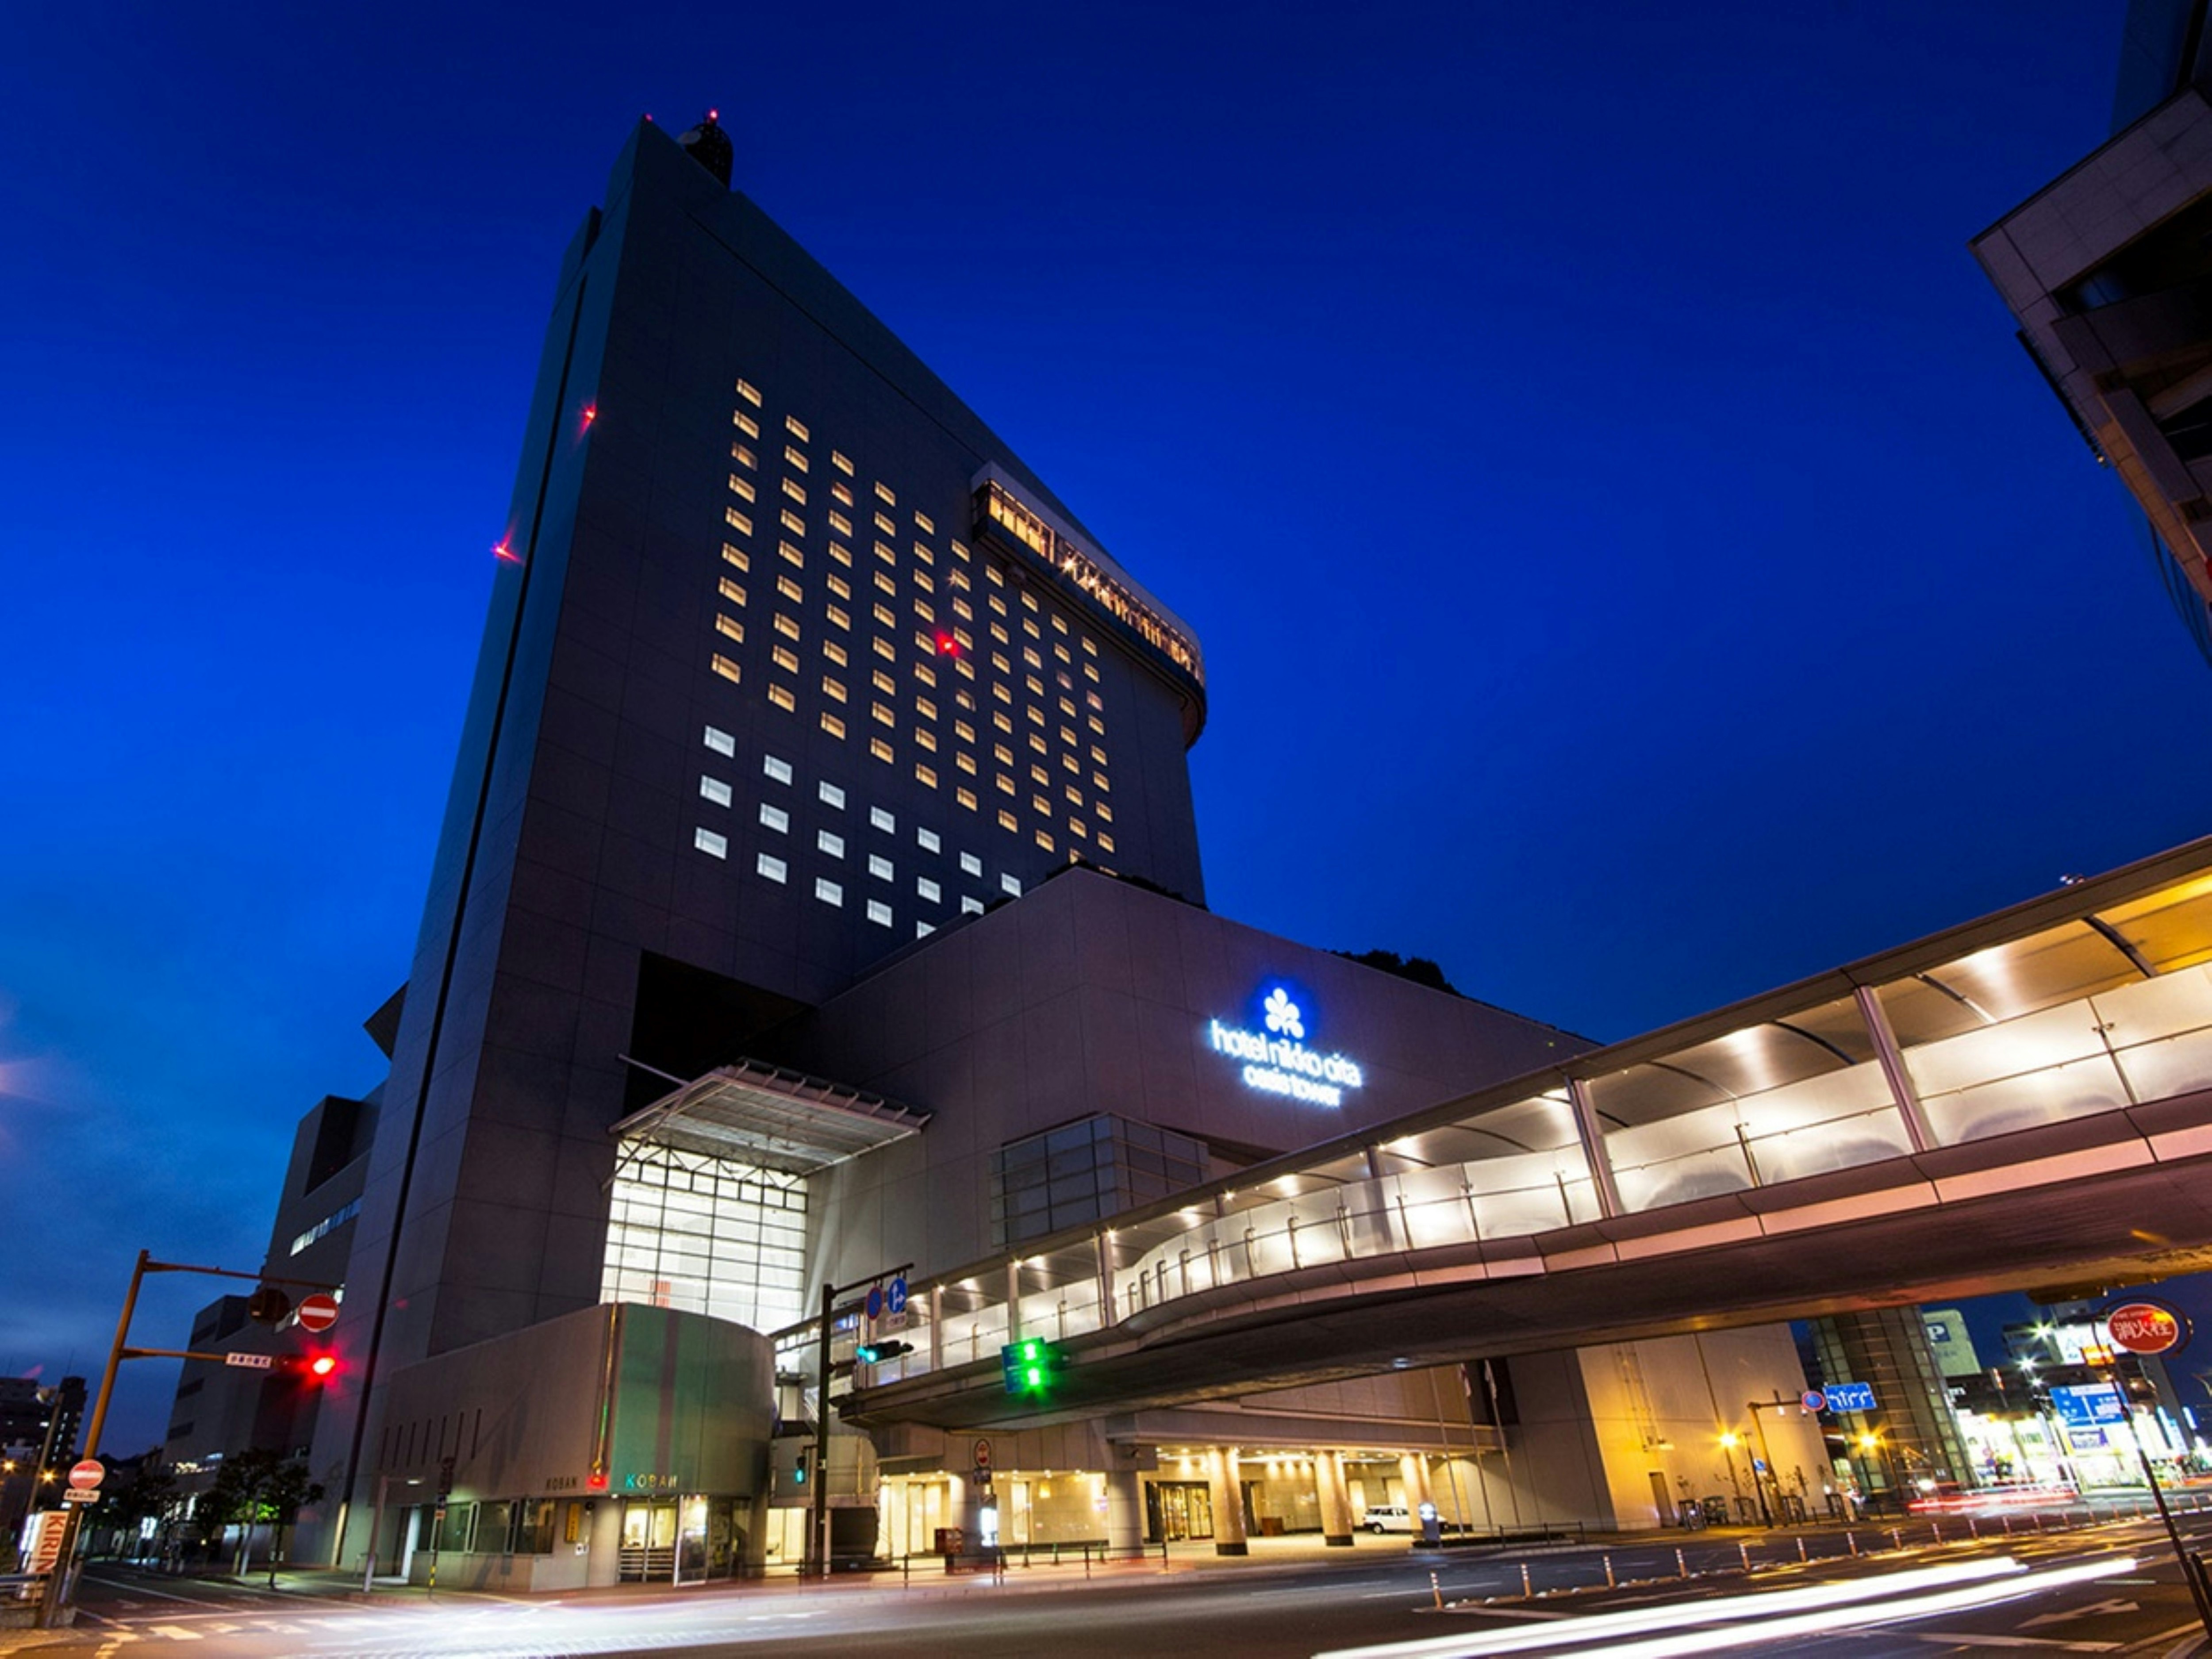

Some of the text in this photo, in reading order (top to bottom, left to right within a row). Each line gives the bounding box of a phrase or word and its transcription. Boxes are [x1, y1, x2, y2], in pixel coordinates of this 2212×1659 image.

[1211, 1018, 1268, 1063] hotel
[1927, 1325, 1945, 1340] P
[625, 1473, 678, 1489] KOBAN
[36, 1515, 66, 1573] KIRIN
